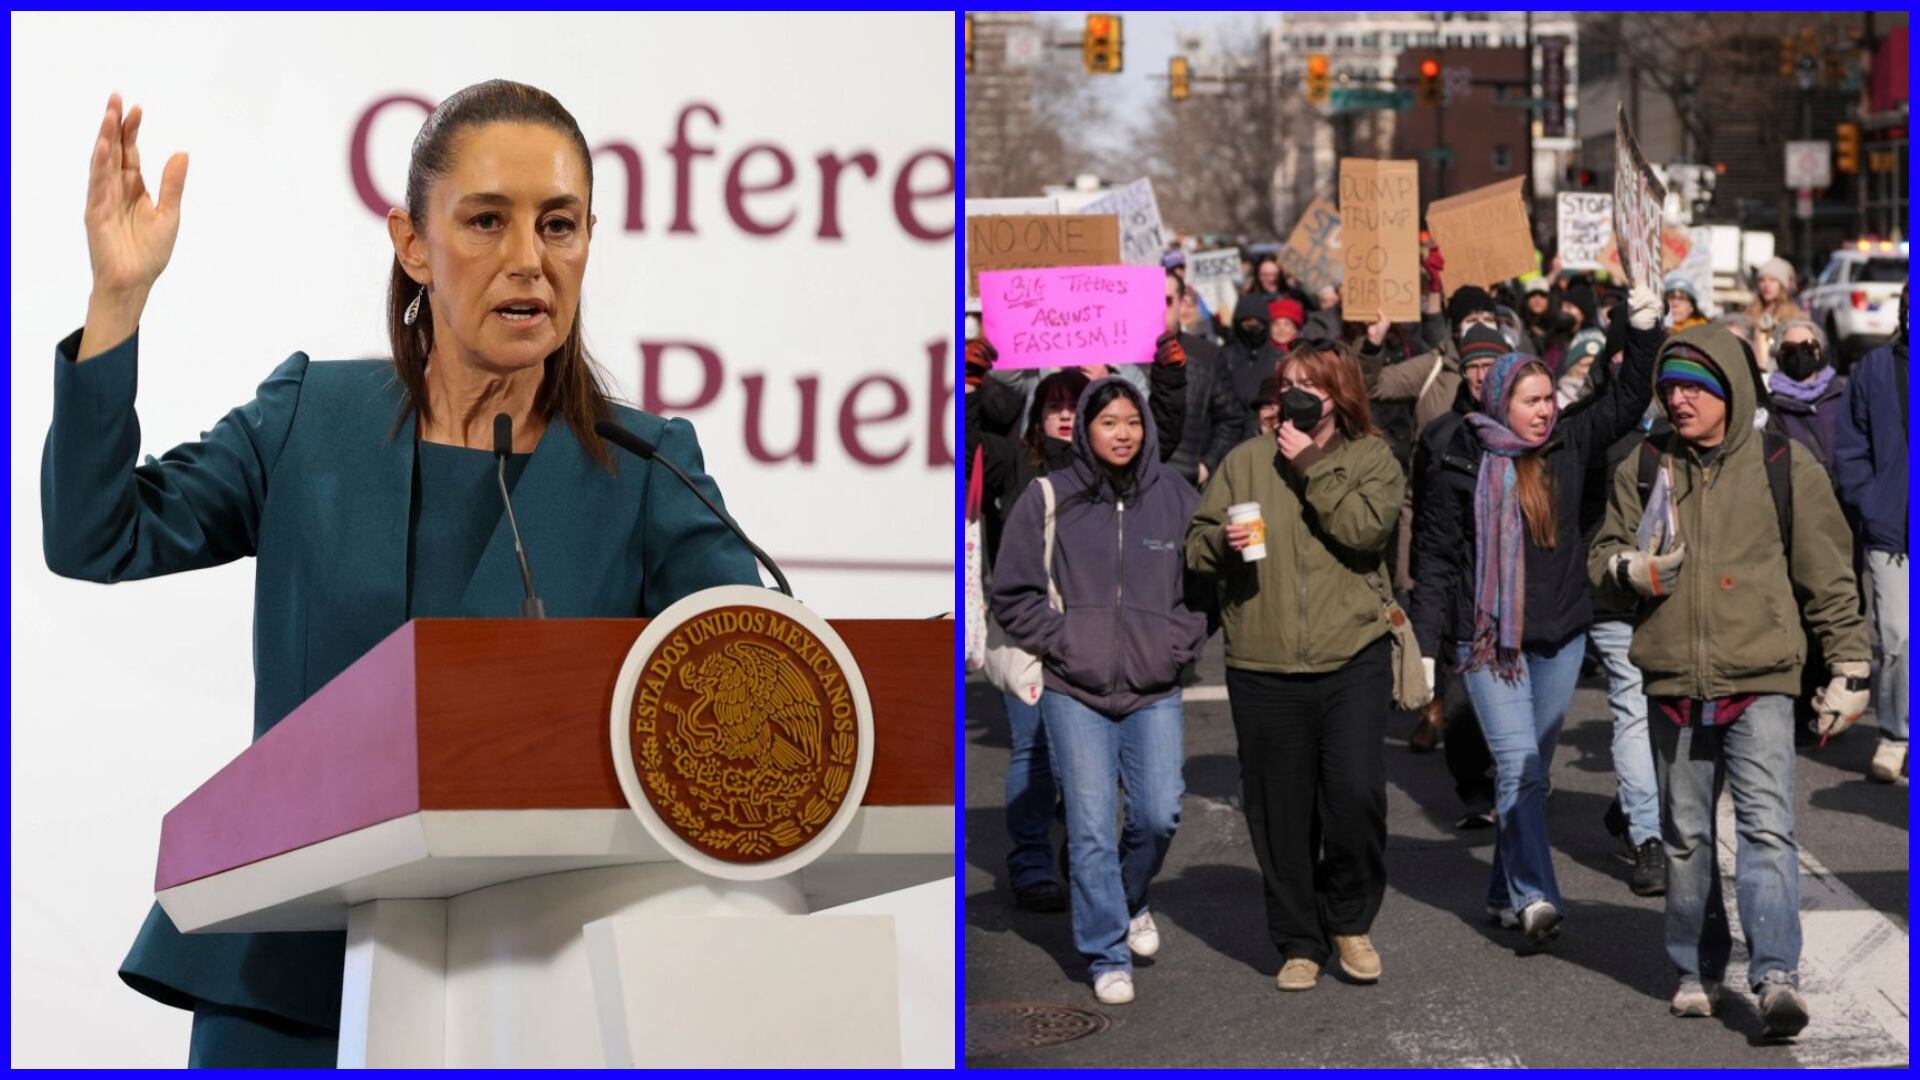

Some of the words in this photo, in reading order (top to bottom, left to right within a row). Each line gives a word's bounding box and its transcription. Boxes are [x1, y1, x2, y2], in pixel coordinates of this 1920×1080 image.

[348, 93, 955, 243] Cnfere
[1342, 174, 1413, 203] DUMP
[1343, 205, 1411, 231] TRUMP
[1562, 196, 1612, 215] STOP
[972, 219, 1015, 255] NO
[1024, 219, 1087, 253] ONE
[1345, 243, 1388, 275] GO
[1348, 276, 1415, 305] BIRDS
[637, 634, 690, 733] ESTADOS
[685, 611, 765, 645] UNIDOS
[767, 614, 853, 733] MEXICANOS
